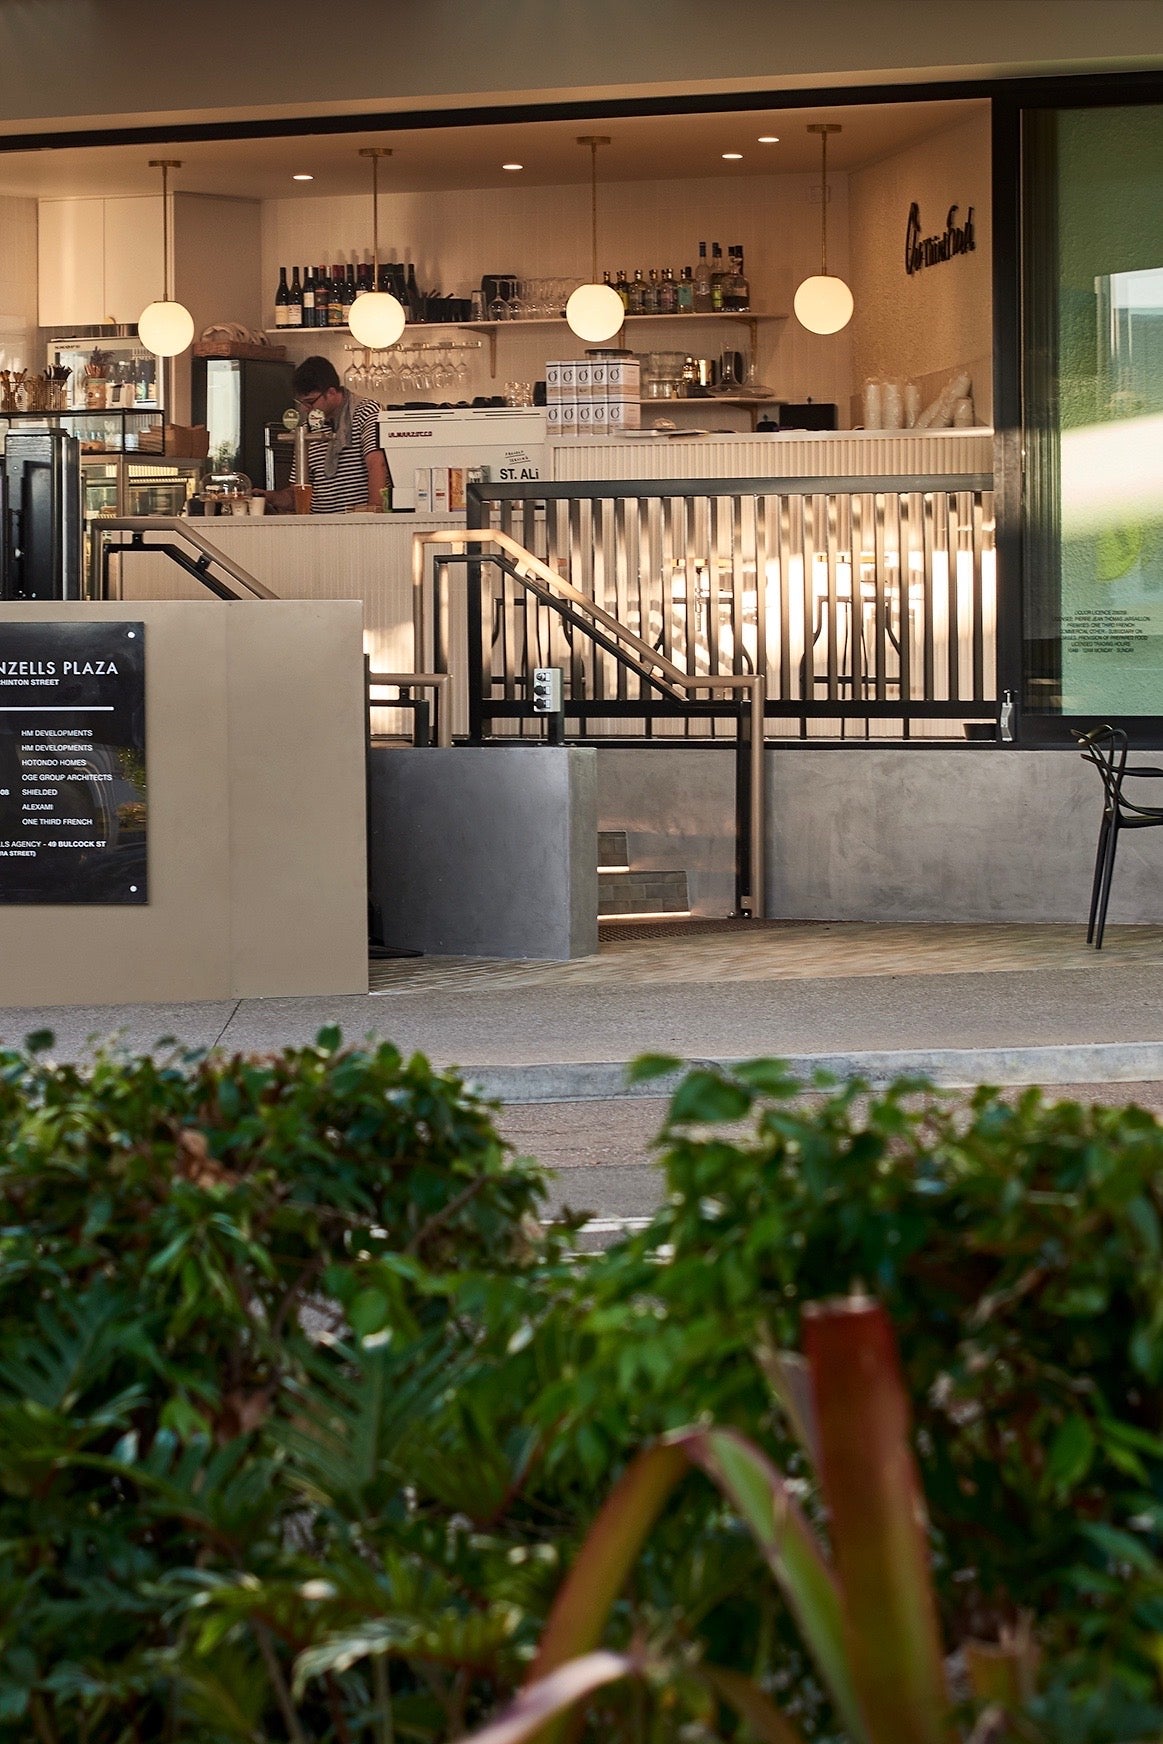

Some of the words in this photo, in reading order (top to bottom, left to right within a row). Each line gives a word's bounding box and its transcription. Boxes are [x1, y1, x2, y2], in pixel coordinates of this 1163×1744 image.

[500, 468, 517, 480] ST.
[63, 662, 119, 675] PLAZA
[9, 850, 36, 858] STREET)
